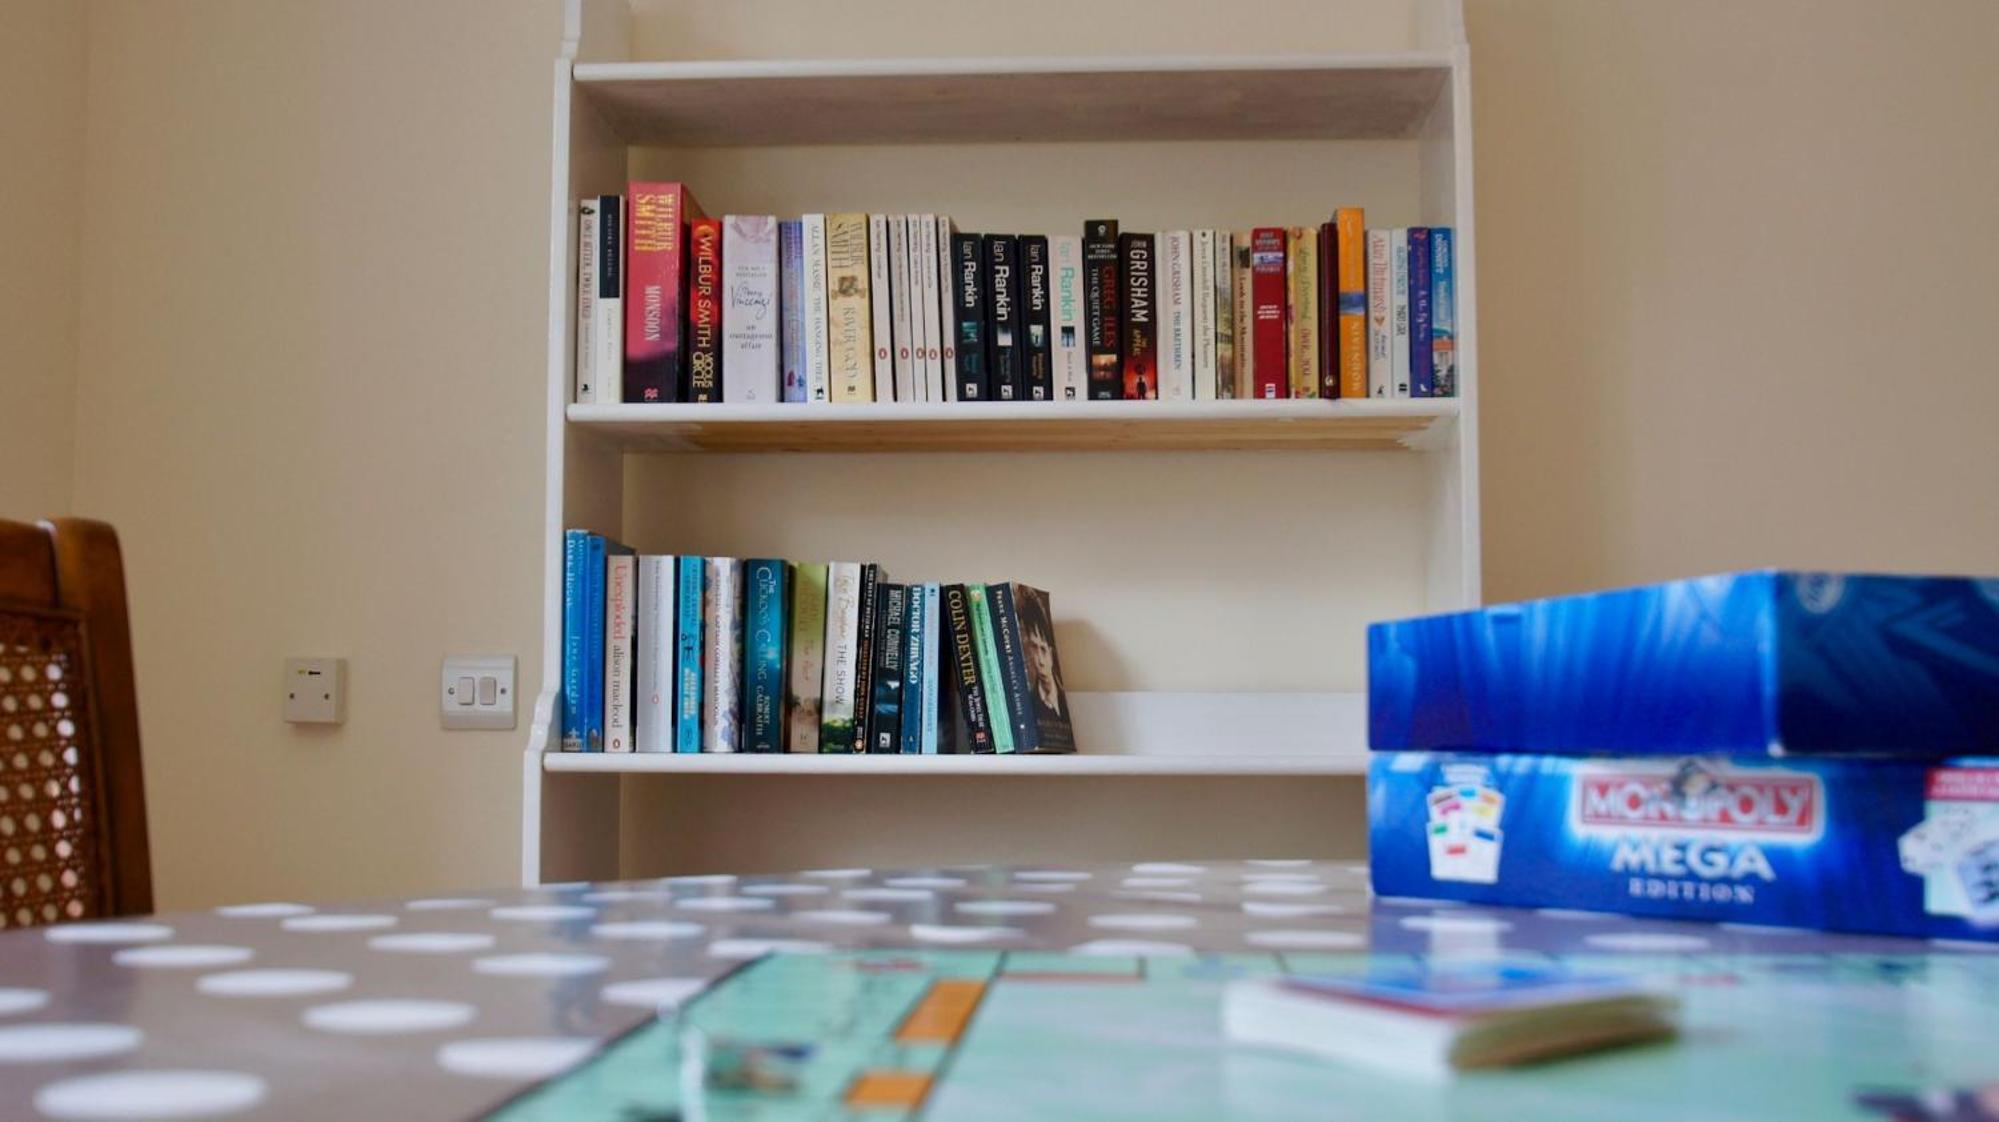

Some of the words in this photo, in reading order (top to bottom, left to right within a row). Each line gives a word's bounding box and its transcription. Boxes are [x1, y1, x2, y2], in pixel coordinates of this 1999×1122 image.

[634, 193, 656, 251] SMITH
[656, 193, 675, 250] WILBUR
[811, 225, 820, 255] ALLAN
[831, 223, 850, 269] SMITH
[850, 222, 864, 265] WILBUR
[963, 241, 974, 259] Ian
[993, 240, 1006, 262] Ian
[1030, 244, 1041, 262] Ian
[1059, 244, 1073, 263] Ian
[1170, 236, 1180, 261] JOHN
[698, 236, 712, 295] WILBUR
[964, 261, 978, 307] Rankin
[1091, 269, 1099, 283] THE
[1129, 249, 1149, 322] GRISHAM
[1172, 262, 1182, 305] GRISHAM
[813, 297, 821, 313] THE
[994, 265, 1011, 321] Rankin
[1031, 264, 1044, 310] Rankin
[1060, 267, 1076, 321] Rankin
[1090, 286, 1100, 316] QUIET
[1103, 266, 1117, 309] GREG
[1239, 277, 1247, 298] Look
[644, 285, 662, 340] MONSOON
[697, 299, 712, 347] SMITH
[843, 307, 857, 345] RIVER
[1092, 317, 1101, 345] GAME
[1104, 316, 1118, 347] ILES
[1173, 311, 1182, 324] THE
[609, 564, 627, 640] Unexploded
[756, 566, 772, 626] CUCKOO'S
[768, 579, 776, 594] THE
[887, 589, 901, 625] MICHAEL
[995, 589, 1004, 615] FRANK
[911, 586, 921, 633] DOCTOR
[948, 590, 967, 632] COLIN
[611, 644, 626, 678] alison
[836, 644, 847, 666] THE
[885, 628, 900, 671] CONNELLY
[909, 634, 920, 684] ZHIVAGO
[955, 634, 976, 685] DEXTER
[611, 680, 626, 728] macleod
[835, 670, 847, 705] SHOW
[755, 685, 764, 736] GALBRAITH
[1611, 840, 1777, 882] MEGA
[1629, 877, 1755, 904] EDITION
